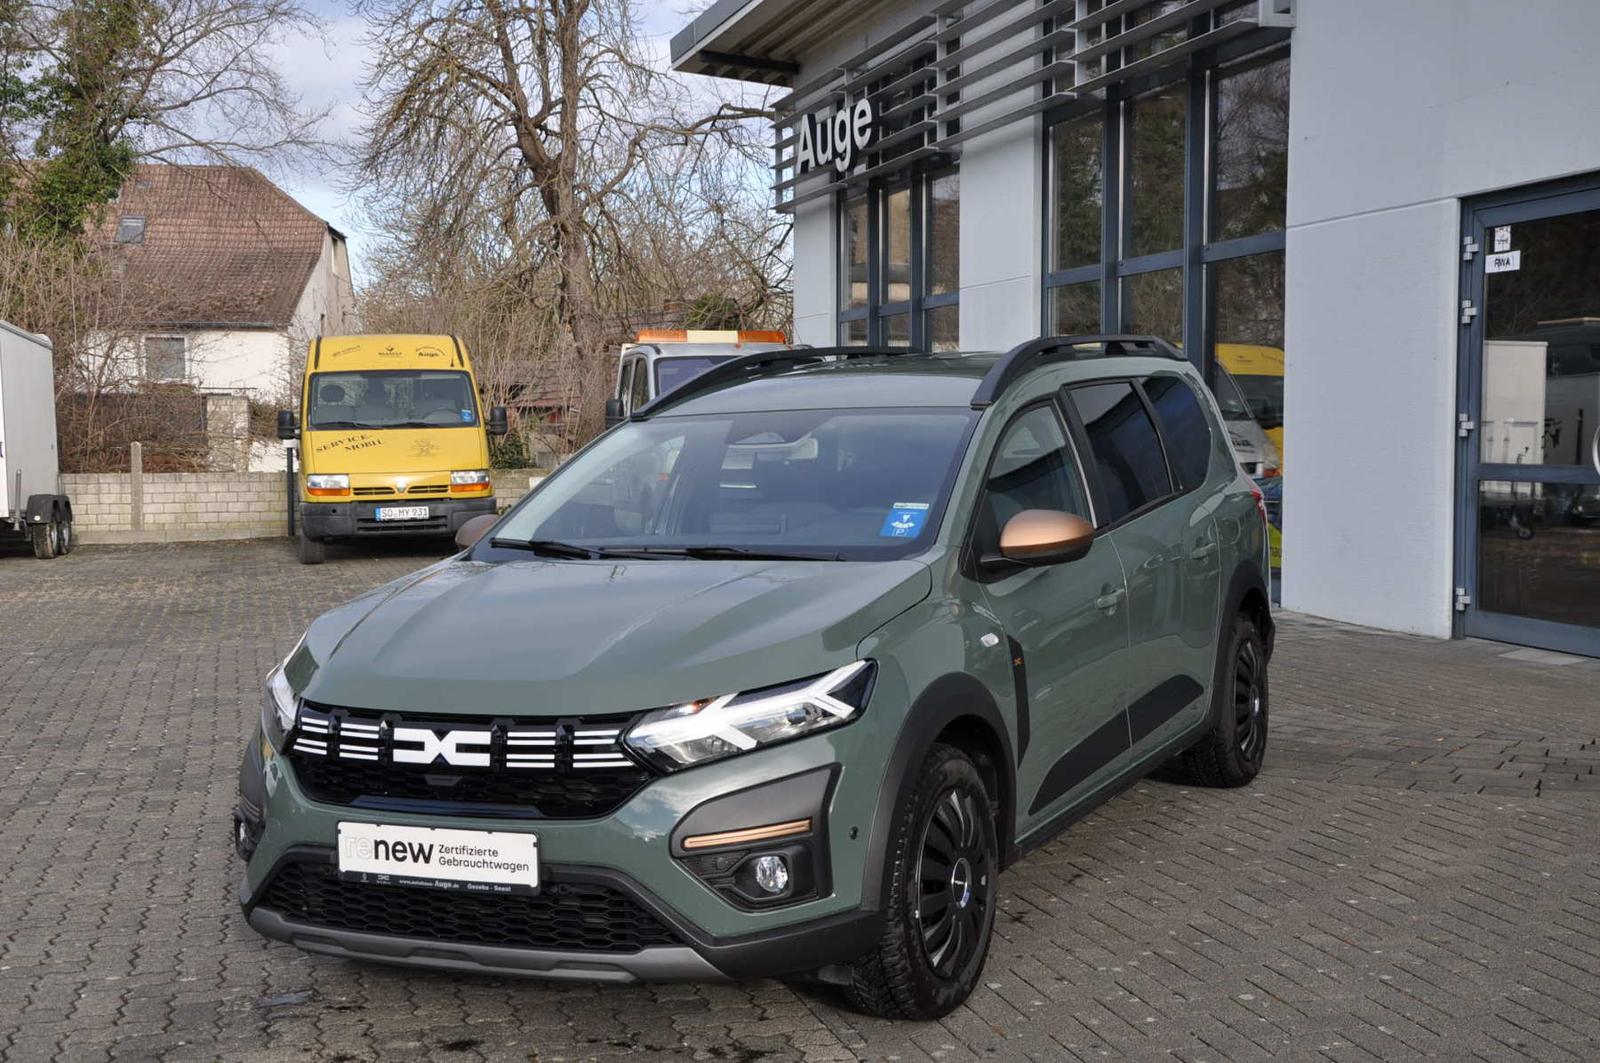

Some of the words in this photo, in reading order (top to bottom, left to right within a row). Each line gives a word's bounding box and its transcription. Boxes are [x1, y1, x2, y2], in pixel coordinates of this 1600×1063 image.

[796, 98, 872, 172] Auge
[1494, 257, 1510, 267] RWA
[399, 508, 409, 517] MY
[345, 837, 433, 864] renew
[438, 844, 499, 857] Zertifizierte
[439, 857, 529, 873] Gebrauchtwagen
